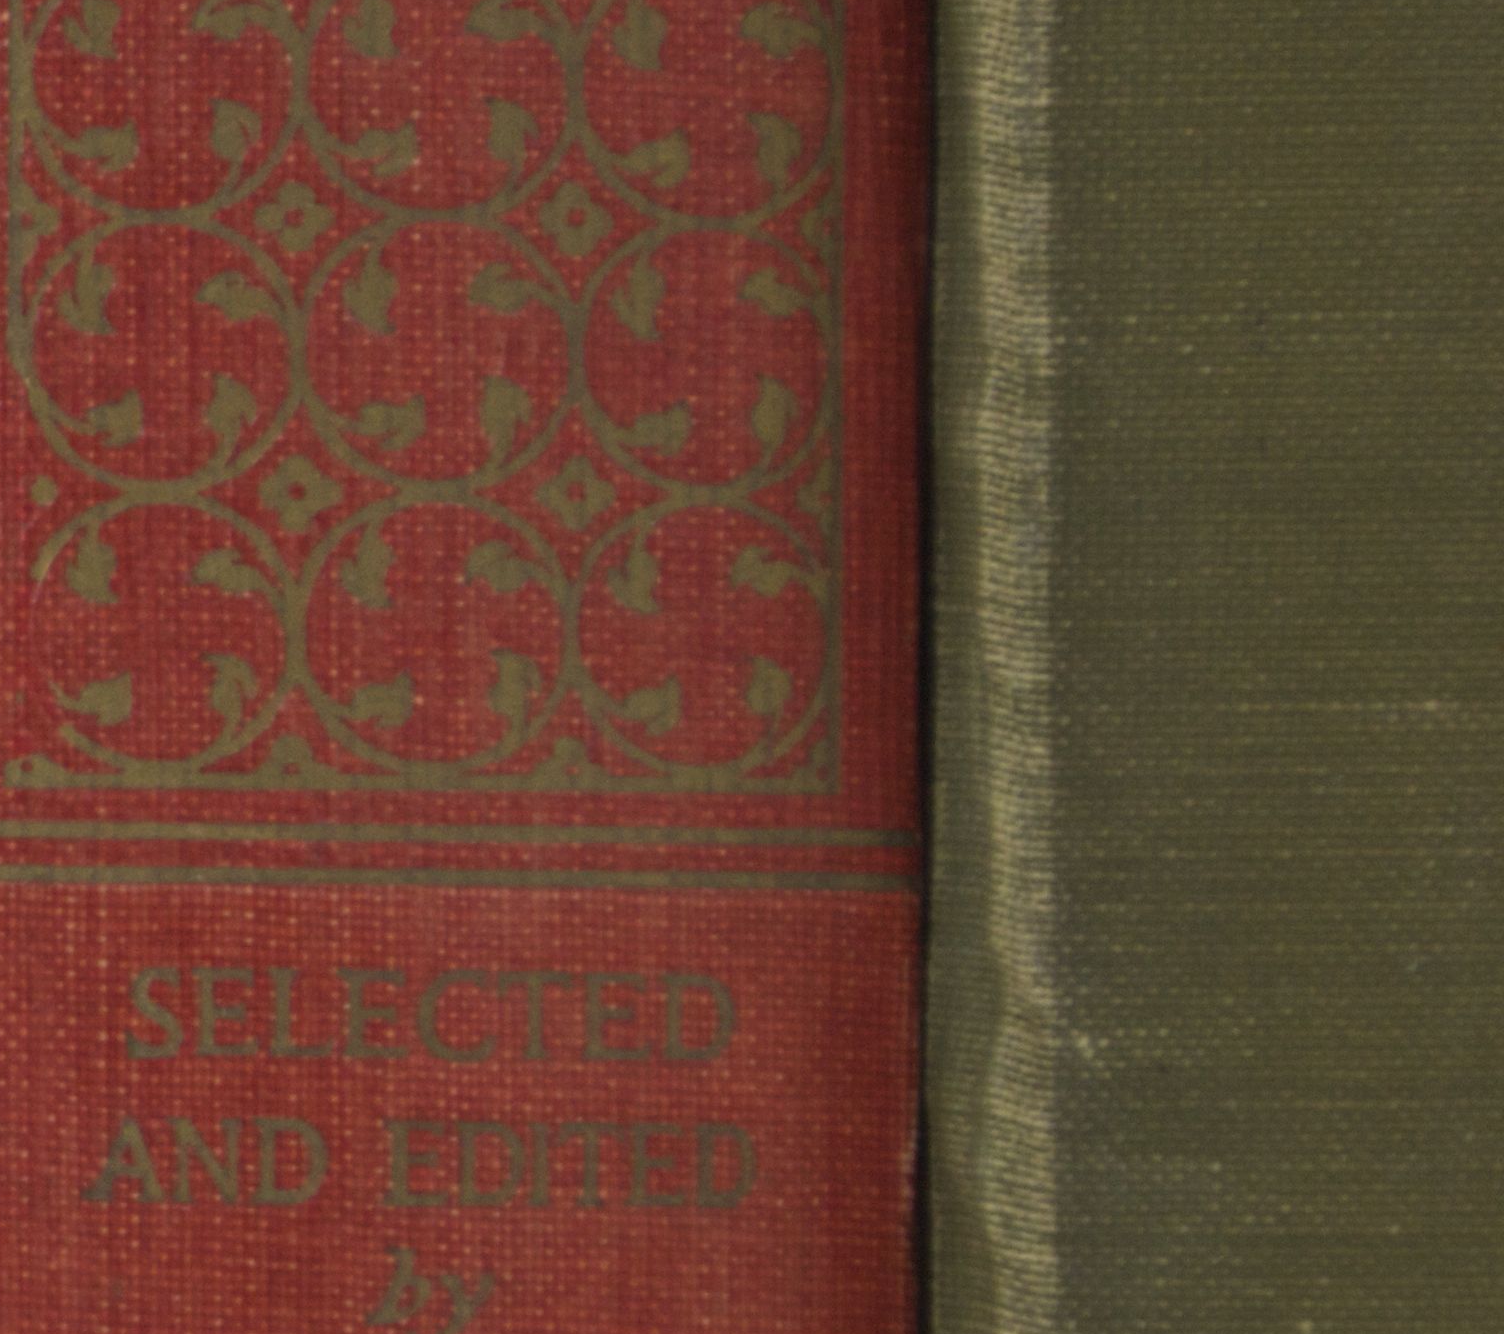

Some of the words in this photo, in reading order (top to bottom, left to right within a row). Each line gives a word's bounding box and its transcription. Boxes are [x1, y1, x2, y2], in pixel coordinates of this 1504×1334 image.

[124, 965, 738, 1063] SELECTED
[80, 1115, 329, 1208] AND
[381, 1116, 759, 1210] EDITED
